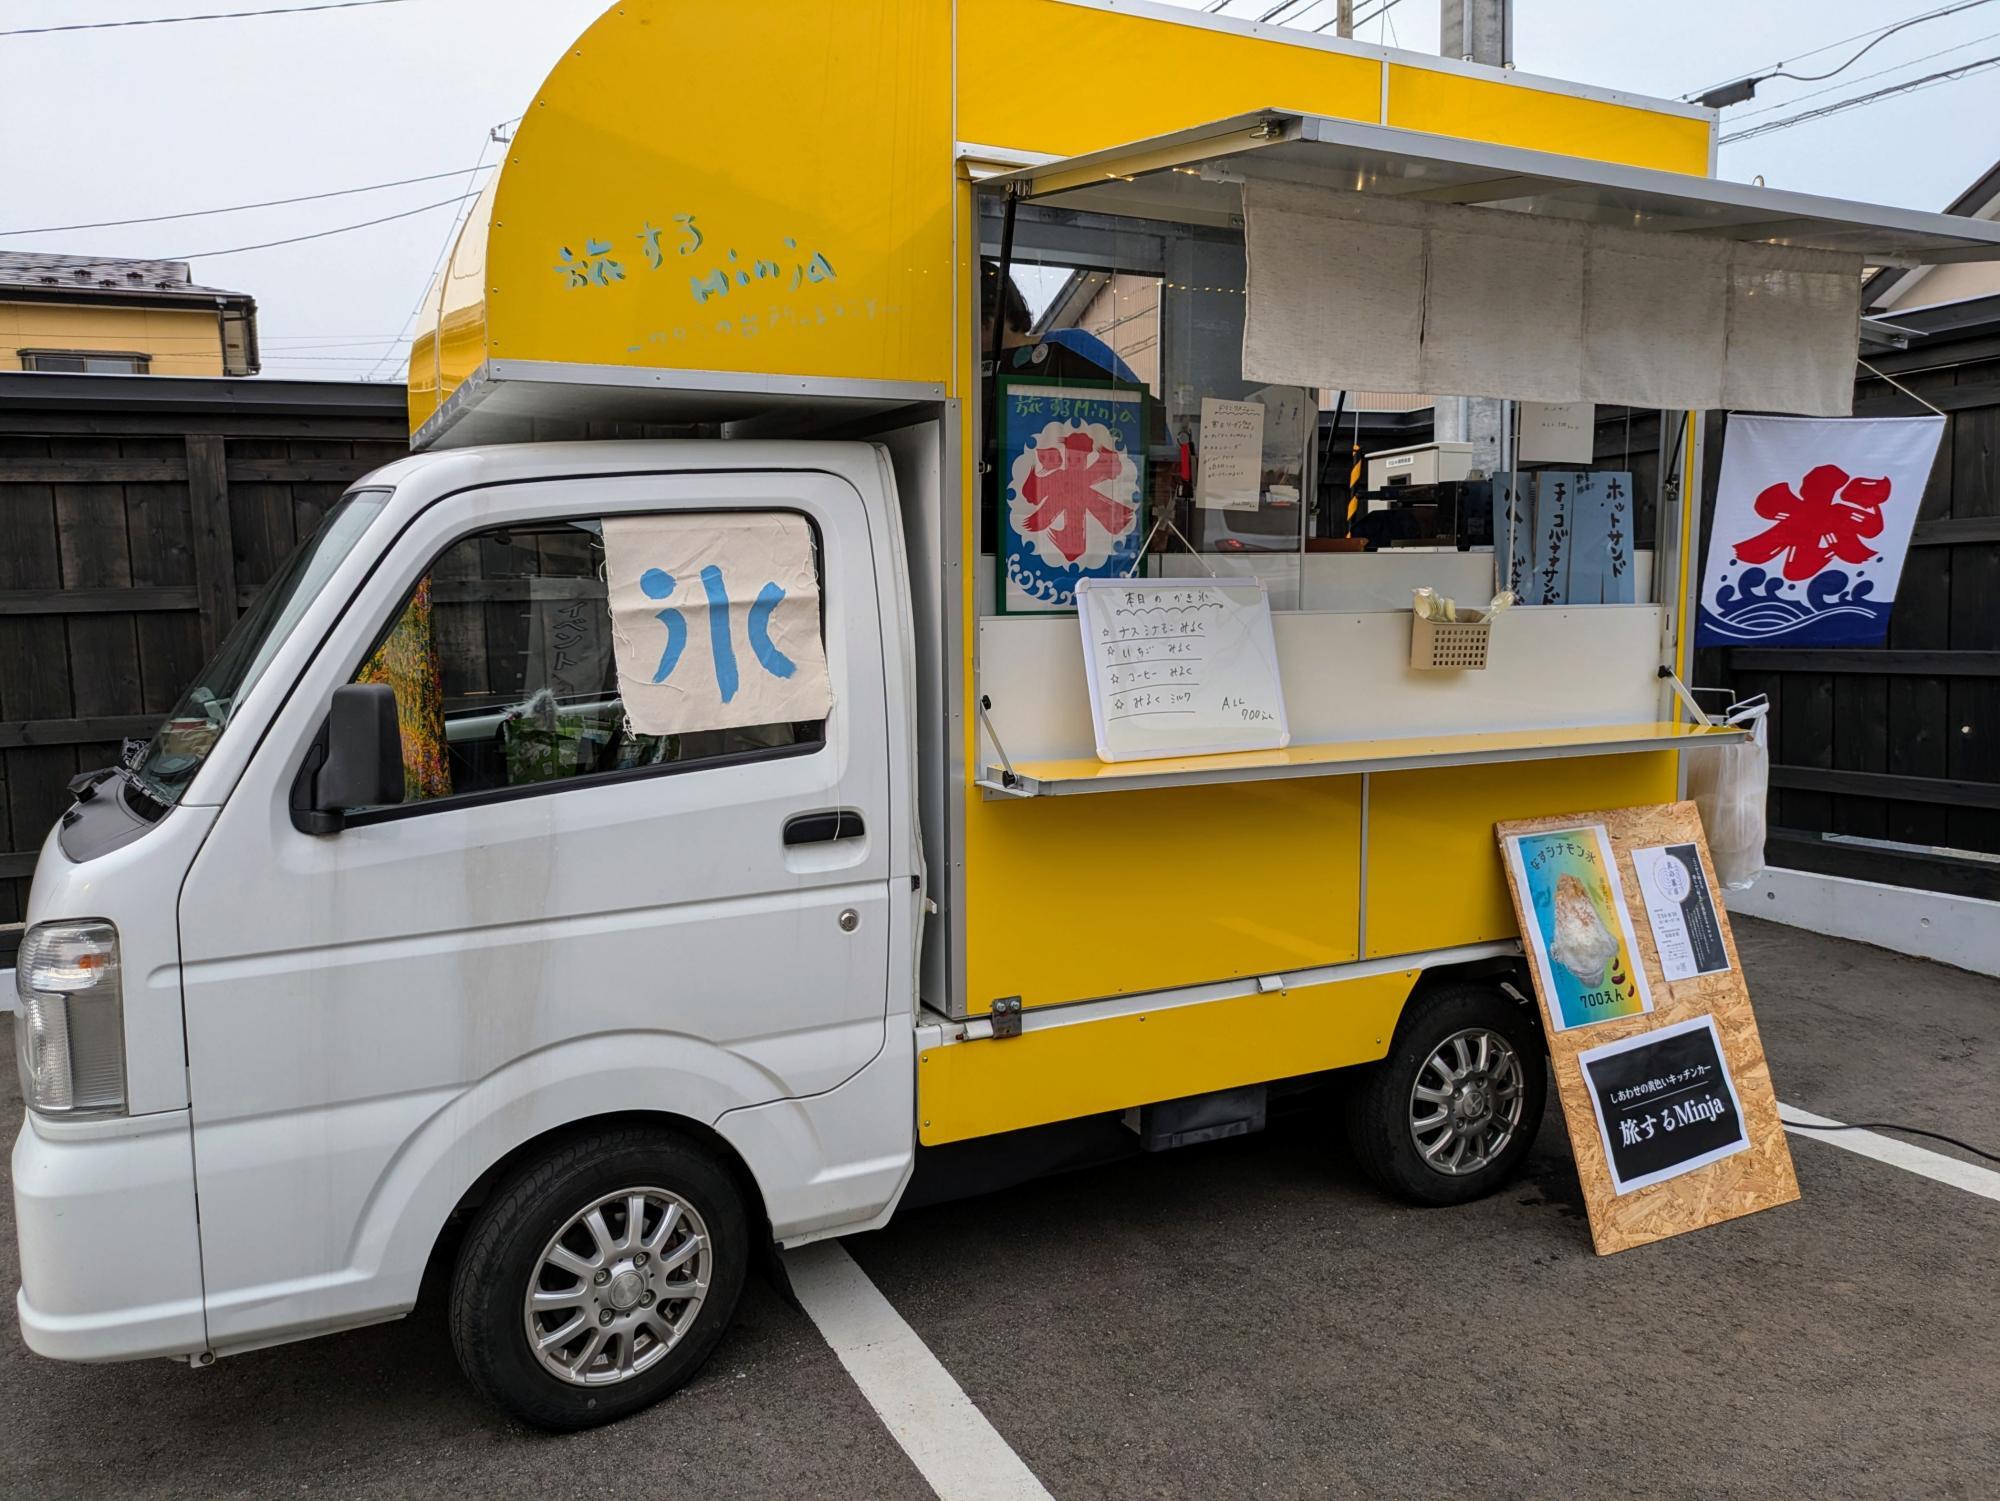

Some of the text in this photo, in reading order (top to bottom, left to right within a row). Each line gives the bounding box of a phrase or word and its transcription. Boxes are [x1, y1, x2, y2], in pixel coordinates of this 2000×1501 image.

[1606, 477, 1626, 578] ホットサンド
[1732, 464, 1892, 581] 氷
[640, 564, 798, 704] 氷
[1579, 988, 1625, 1008] 700えん
[1610, 1064, 1712, 1105] しあわせの黄色いキッチンカー
[1618, 1094, 1726, 1148] 旅するMinja
